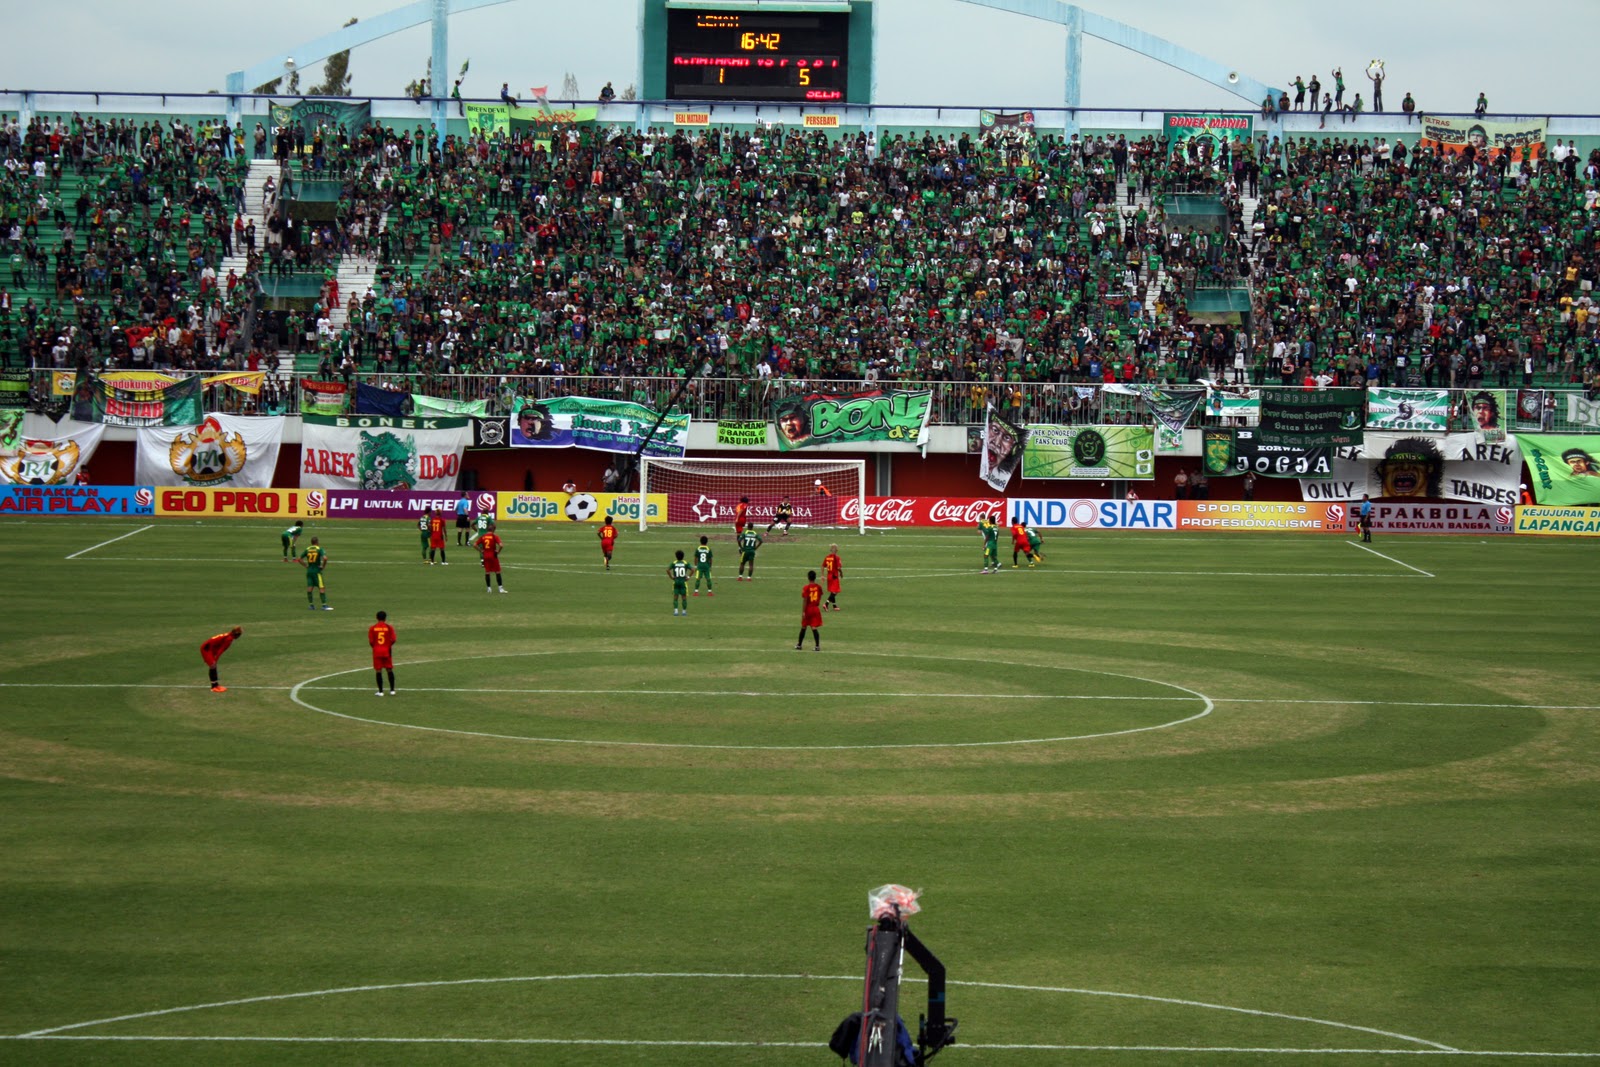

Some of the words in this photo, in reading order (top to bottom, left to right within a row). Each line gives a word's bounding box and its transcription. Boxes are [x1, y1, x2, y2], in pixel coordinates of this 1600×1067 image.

[741, 33, 780, 50] 16:42
[719, 67, 724, 84] 1
[799, 68, 810, 85] 5
[806, 116, 837, 125] PERSEBAYA
[1169, 116, 1208, 127] BONEK
[1209, 117, 1248, 129] MANIA
[1425, 117, 1450, 126] ULTRAS
[1494, 128, 1542, 146] FORCE
[106, 398, 164, 418] BLITAR
[1281, 410, 1303, 419] Green
[336, 417, 437, 429] BONEK
[718, 435, 765, 445] PASURUAN
[1051, 438, 1068, 446] CLUB
[1462, 444, 1514, 465] AREK
[304, 448, 355, 478] AREK
[419, 453, 459, 480] IDJO
[1236, 456, 1330, 473] JOGJA
[13, 487, 98, 497] TEGAKKAN
[1308, 482, 1354, 499] ONLY
[1451, 480, 1516, 505] TANDES
[49, 497, 117, 512] PLAY
[162, 491, 208, 512] GO
[213, 491, 280, 513] PRO
[330, 498, 359, 510] LPI
[364, 500, 403, 508] UNTUK
[506, 498, 558, 518] Jogja
[606, 499, 658, 519] Joga
[720, 506, 754, 516] BAK
[1015, 500, 1172, 528] INDOSIAR
[1197, 504, 1307, 513] SPORTIVITAS
[1522, 508, 1585, 517] KEJUJURAN
[432, 523, 439, 532] 11
[1181, 518, 1322, 528] PROFESIONALISME
[1388, 521, 1444, 529] KESATUAN
[603, 528, 612, 537] 18
[484, 539, 490, 549] 2
[745, 537, 756, 546] 77
[700, 553, 707, 562] 8
[675, 567, 686, 577] 10
[809, 591, 818, 602] 14
[378, 632, 385, 644] 5
